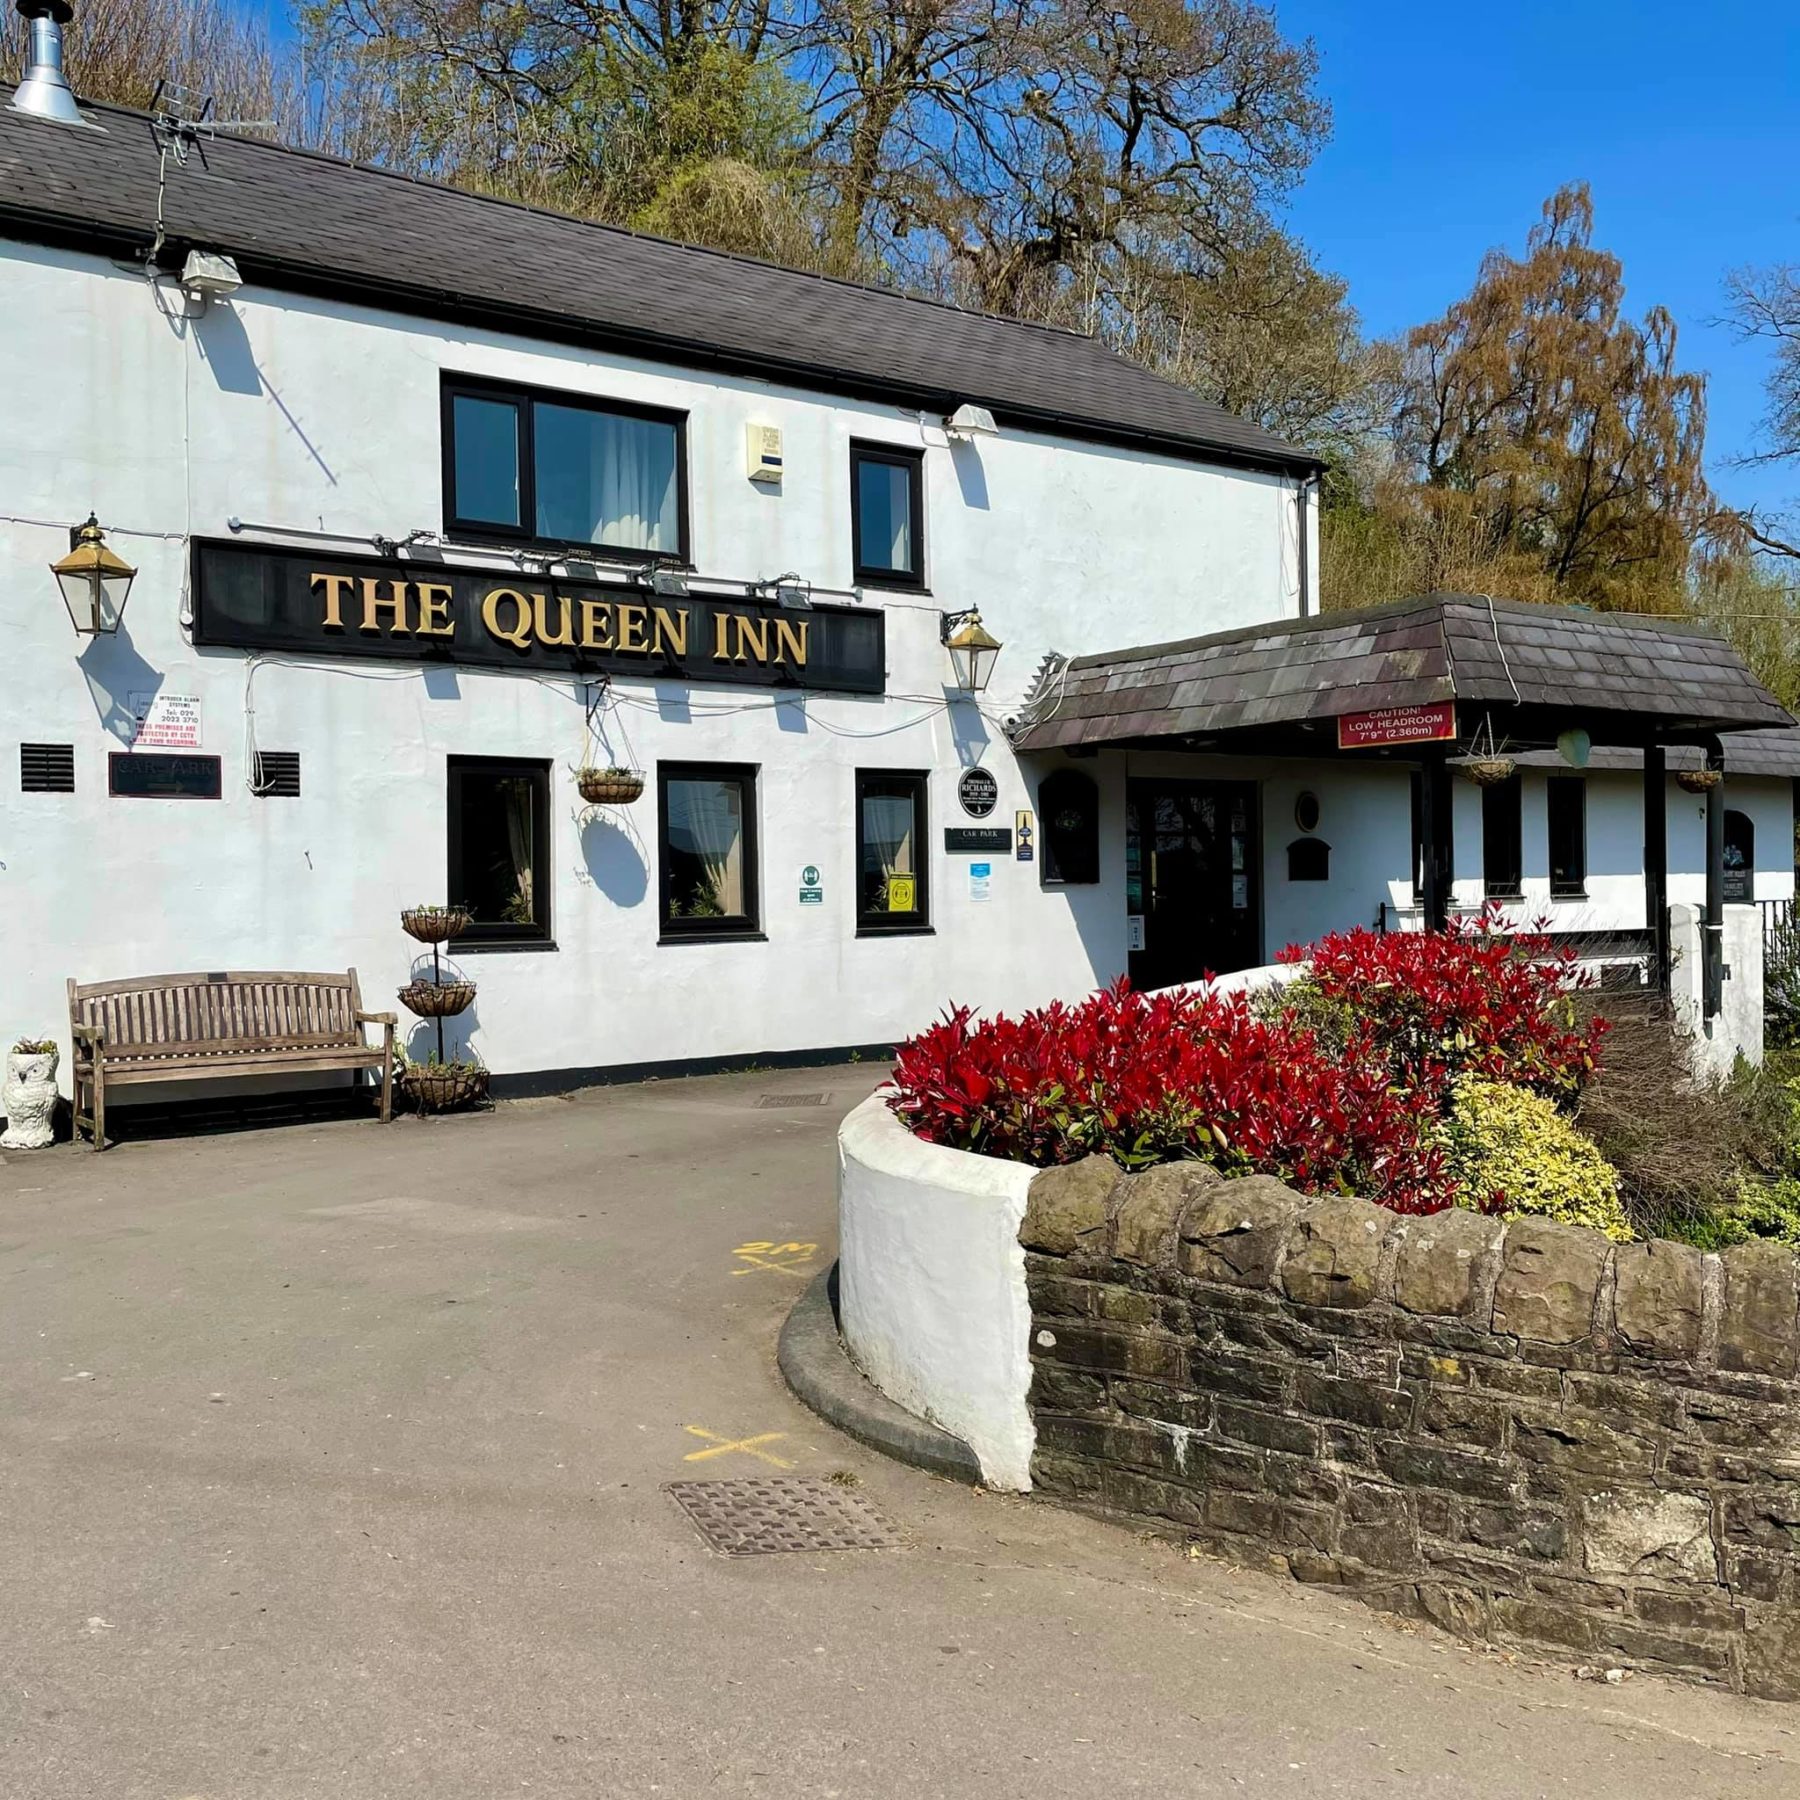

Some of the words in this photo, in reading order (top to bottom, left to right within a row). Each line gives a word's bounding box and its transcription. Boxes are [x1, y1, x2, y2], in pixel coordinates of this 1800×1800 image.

[309, 572, 455, 638] THE
[480, 587, 689, 656] QUEEN
[711, 611, 809, 666] INN
[1369, 706, 1421, 719] CAUTION!
[1348, 721, 1374, 732] LOW
[1377, 714, 1443, 729] HEADROOM
[1386, 726, 1432, 739] (2.360m)
[119, 760, 156, 774] CAR
